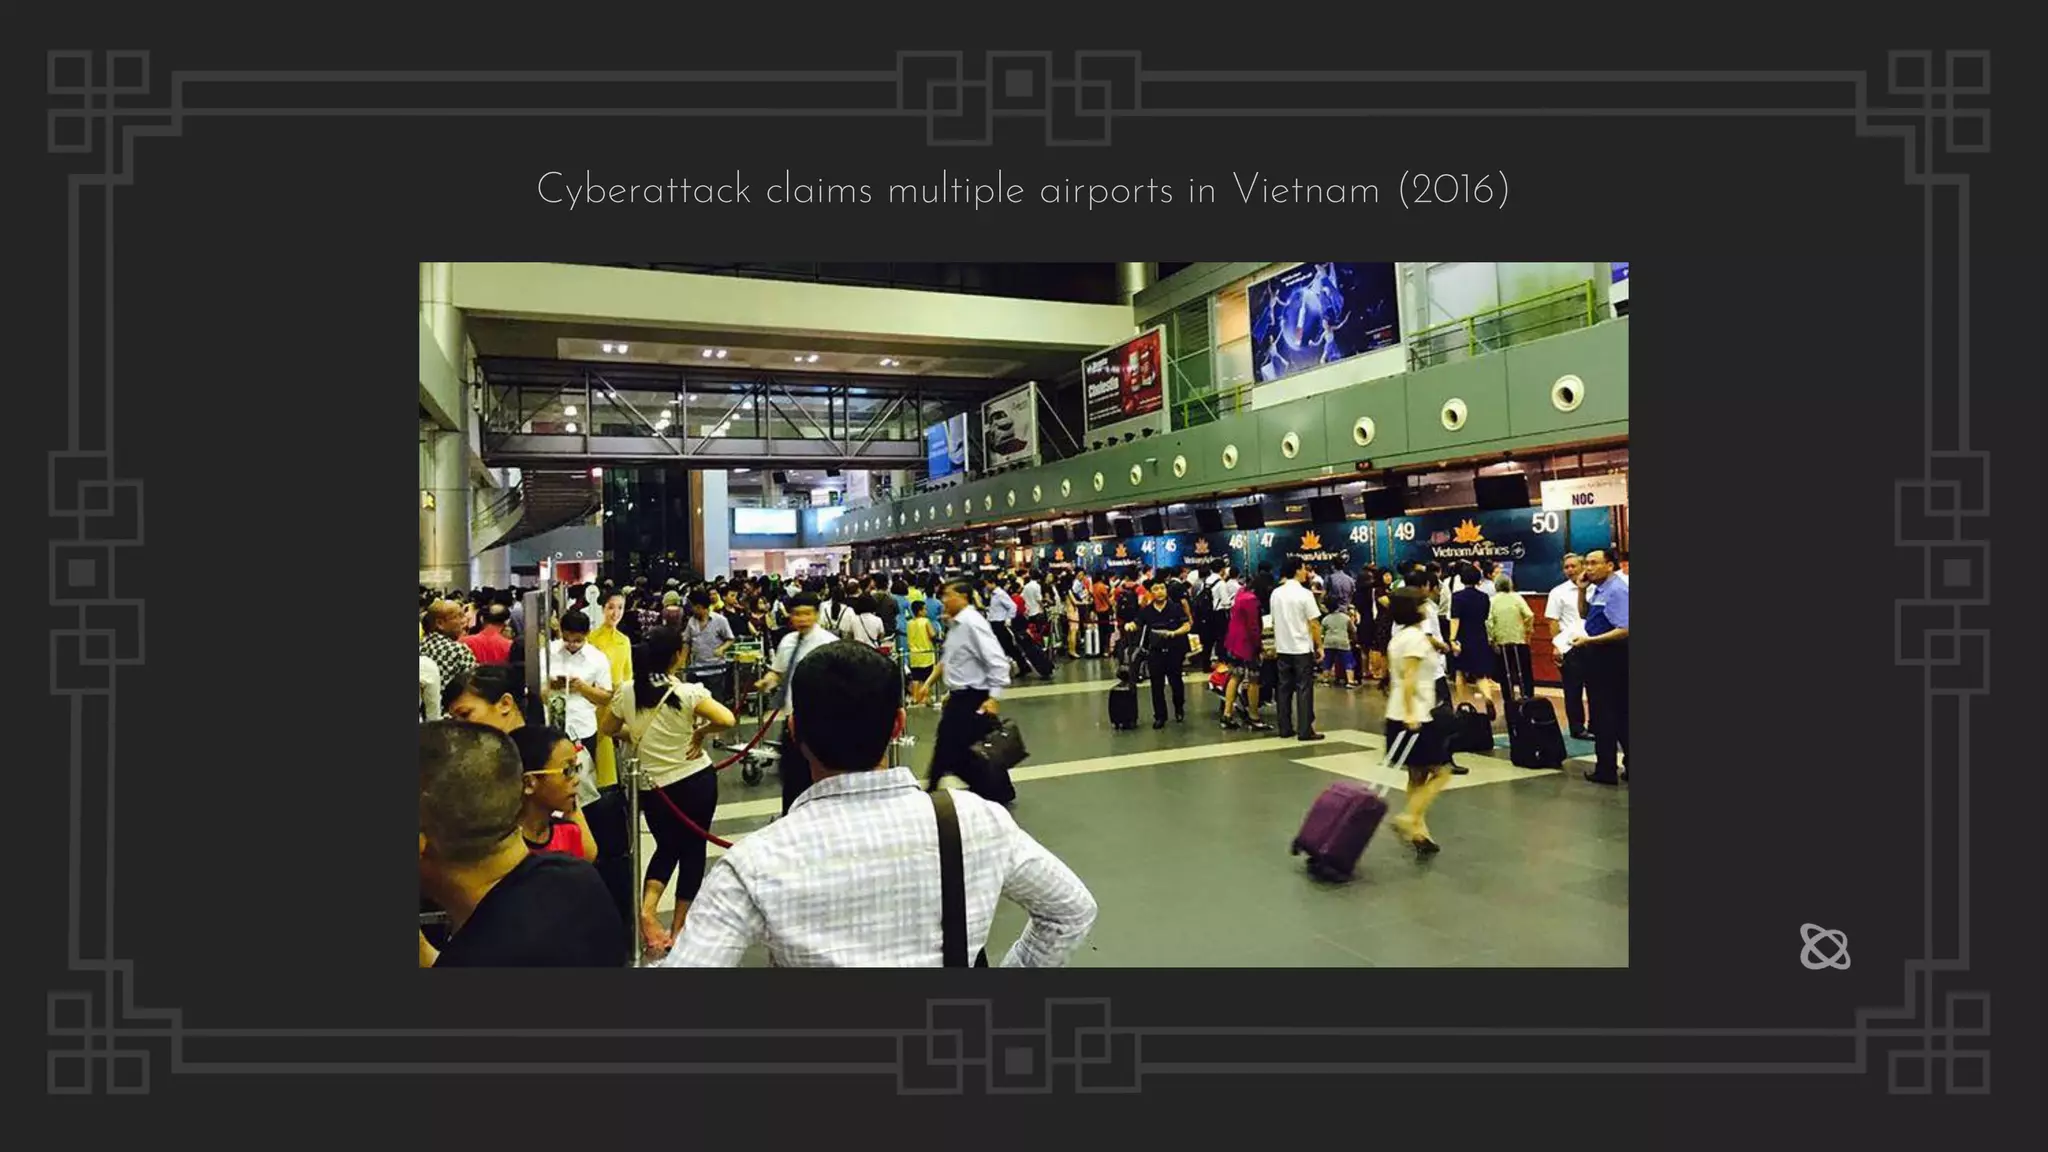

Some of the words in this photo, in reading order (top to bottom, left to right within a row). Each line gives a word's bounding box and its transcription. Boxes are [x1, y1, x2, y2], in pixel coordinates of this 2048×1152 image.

[1572, 492, 1595, 506] NOC
[1532, 511, 1560, 534] 50
[1260, 531, 1276, 548] 47
[1349, 524, 1370, 544] 48
[1394, 522, 1416, 542] 49
[1164, 537, 1177, 553] 45
[1228, 534, 1244, 550] 46
